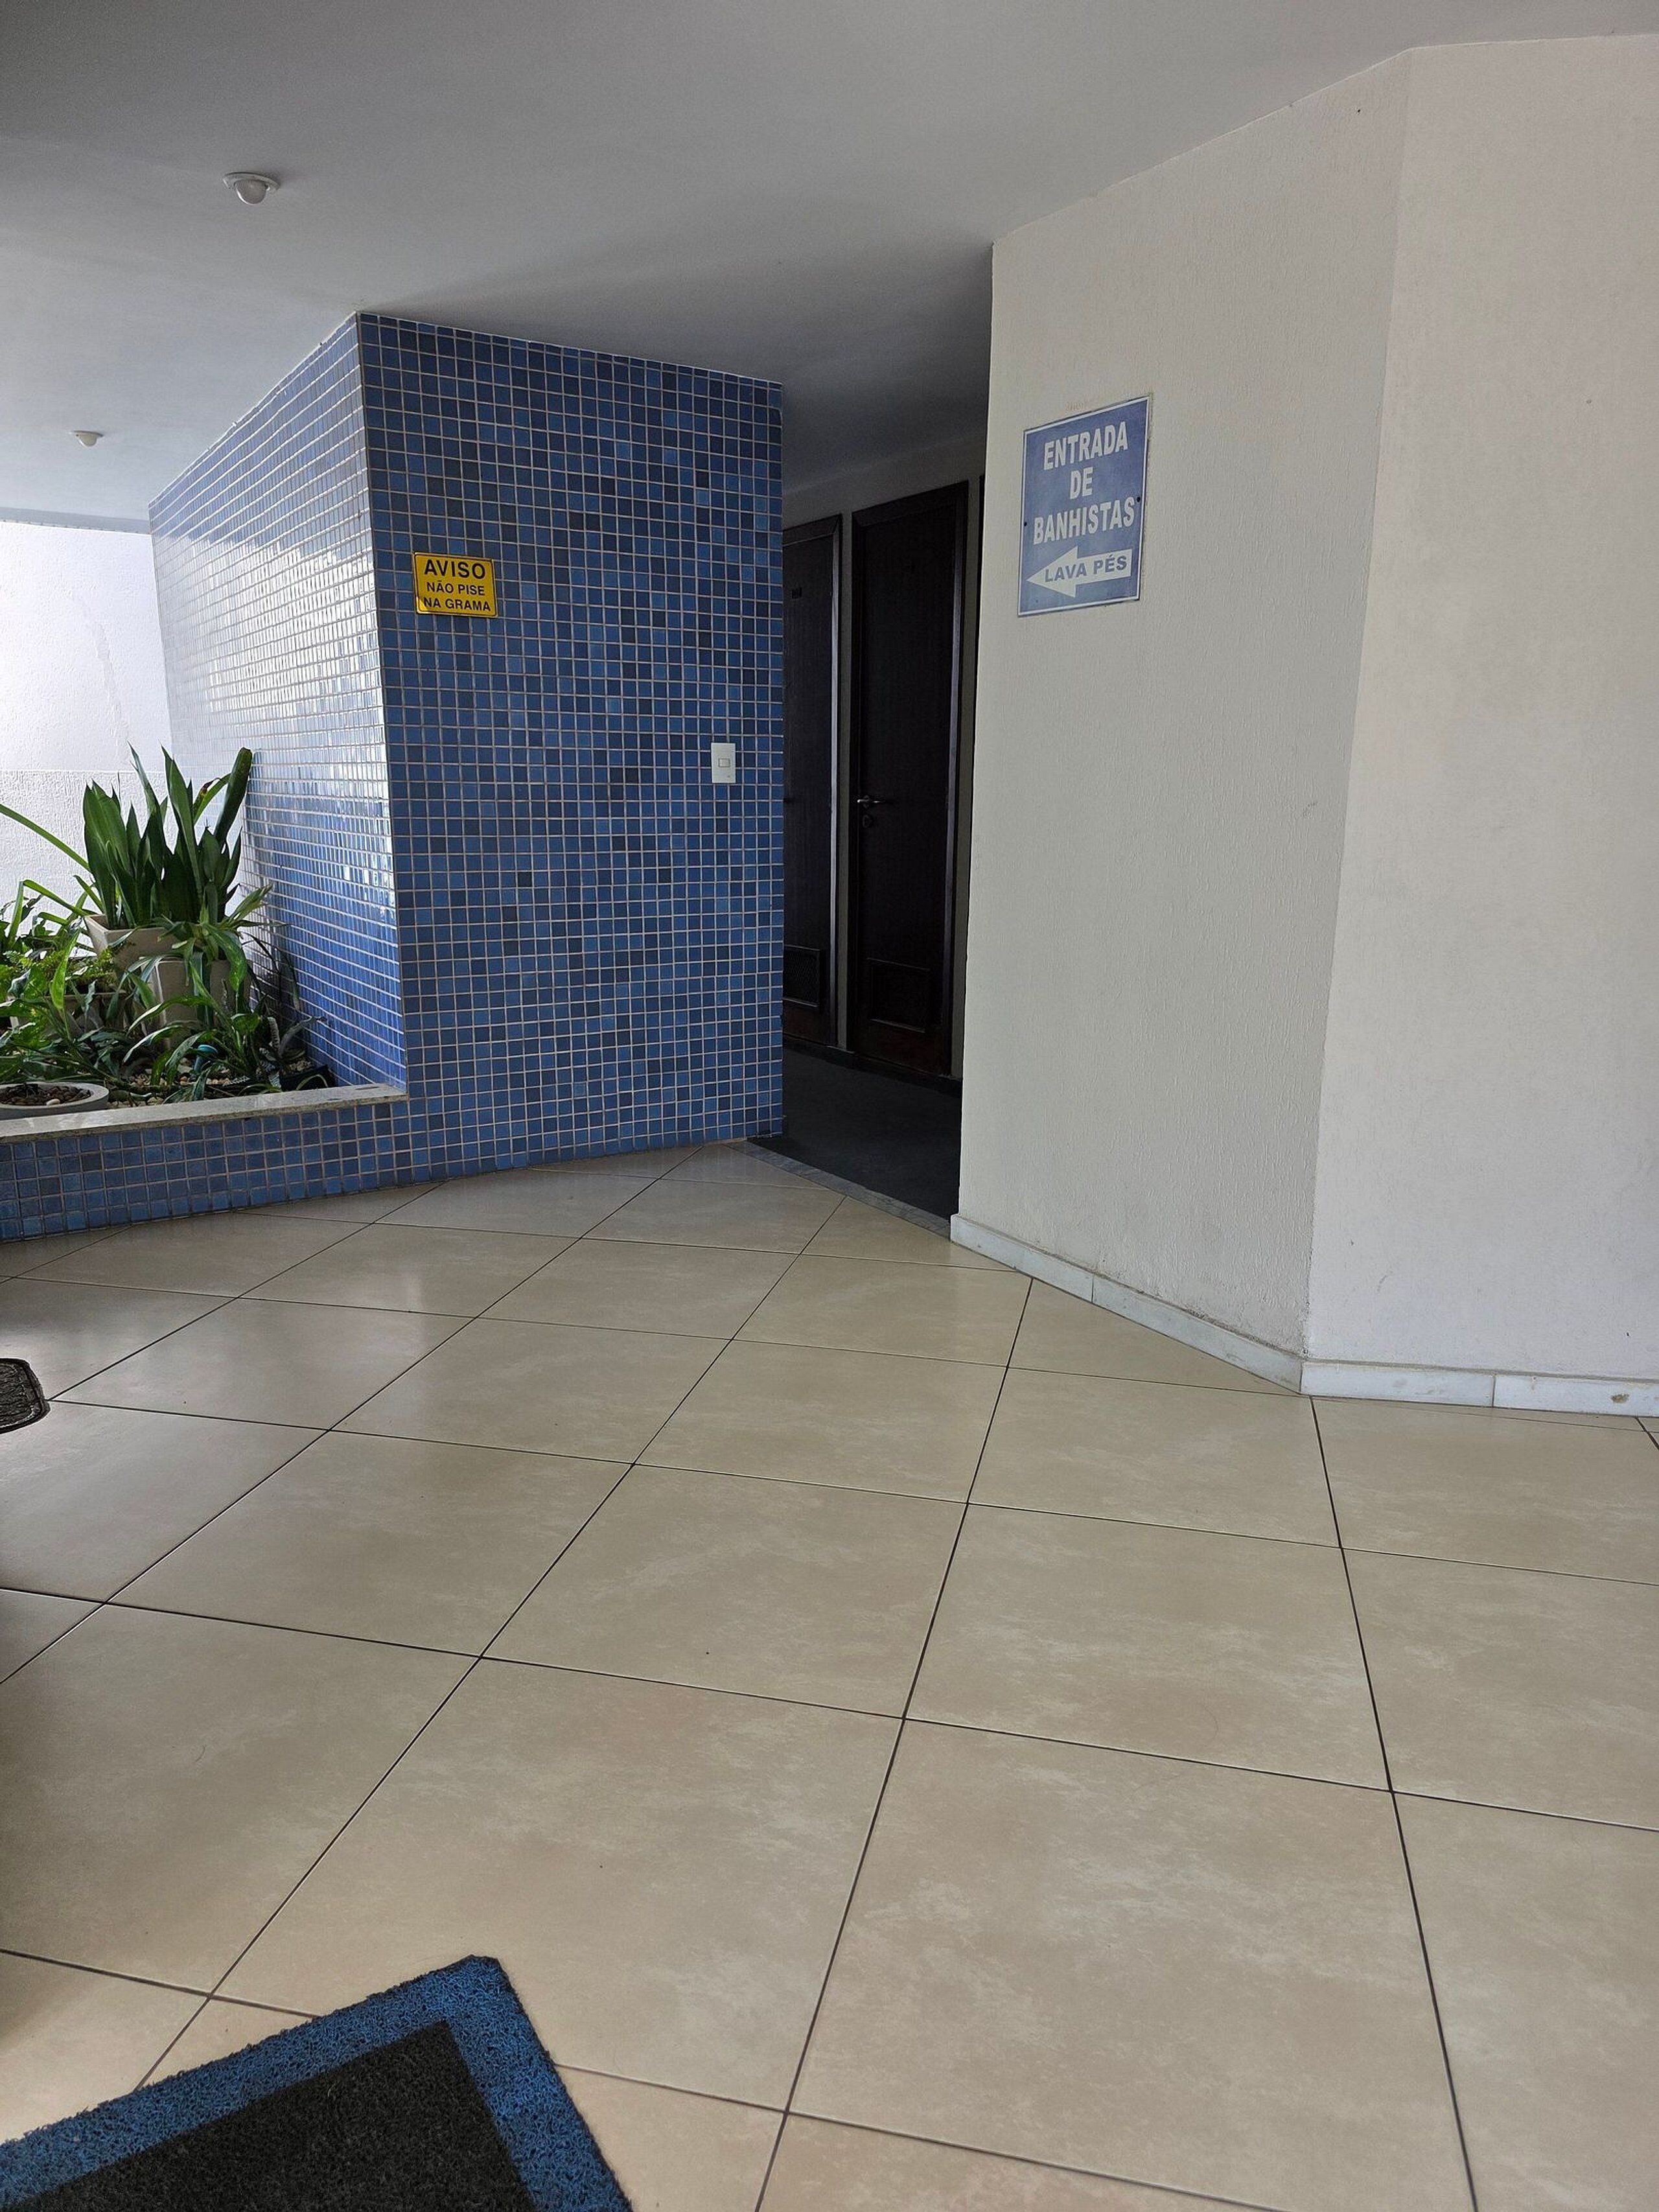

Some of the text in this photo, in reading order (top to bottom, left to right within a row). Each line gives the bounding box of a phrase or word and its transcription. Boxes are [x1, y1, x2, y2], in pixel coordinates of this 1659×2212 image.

[1043, 421, 1128, 471] ENTRADA
[1070, 467, 1094, 500] DE
[1033, 496, 1135, 545] BANHISTAS
[424, 559, 485, 579] AVISO
[1045, 554, 1127, 583] LAVA PÉS
[426, 580, 485, 596] NÃO PISE
[424, 597, 491, 611] NA GRAMA
